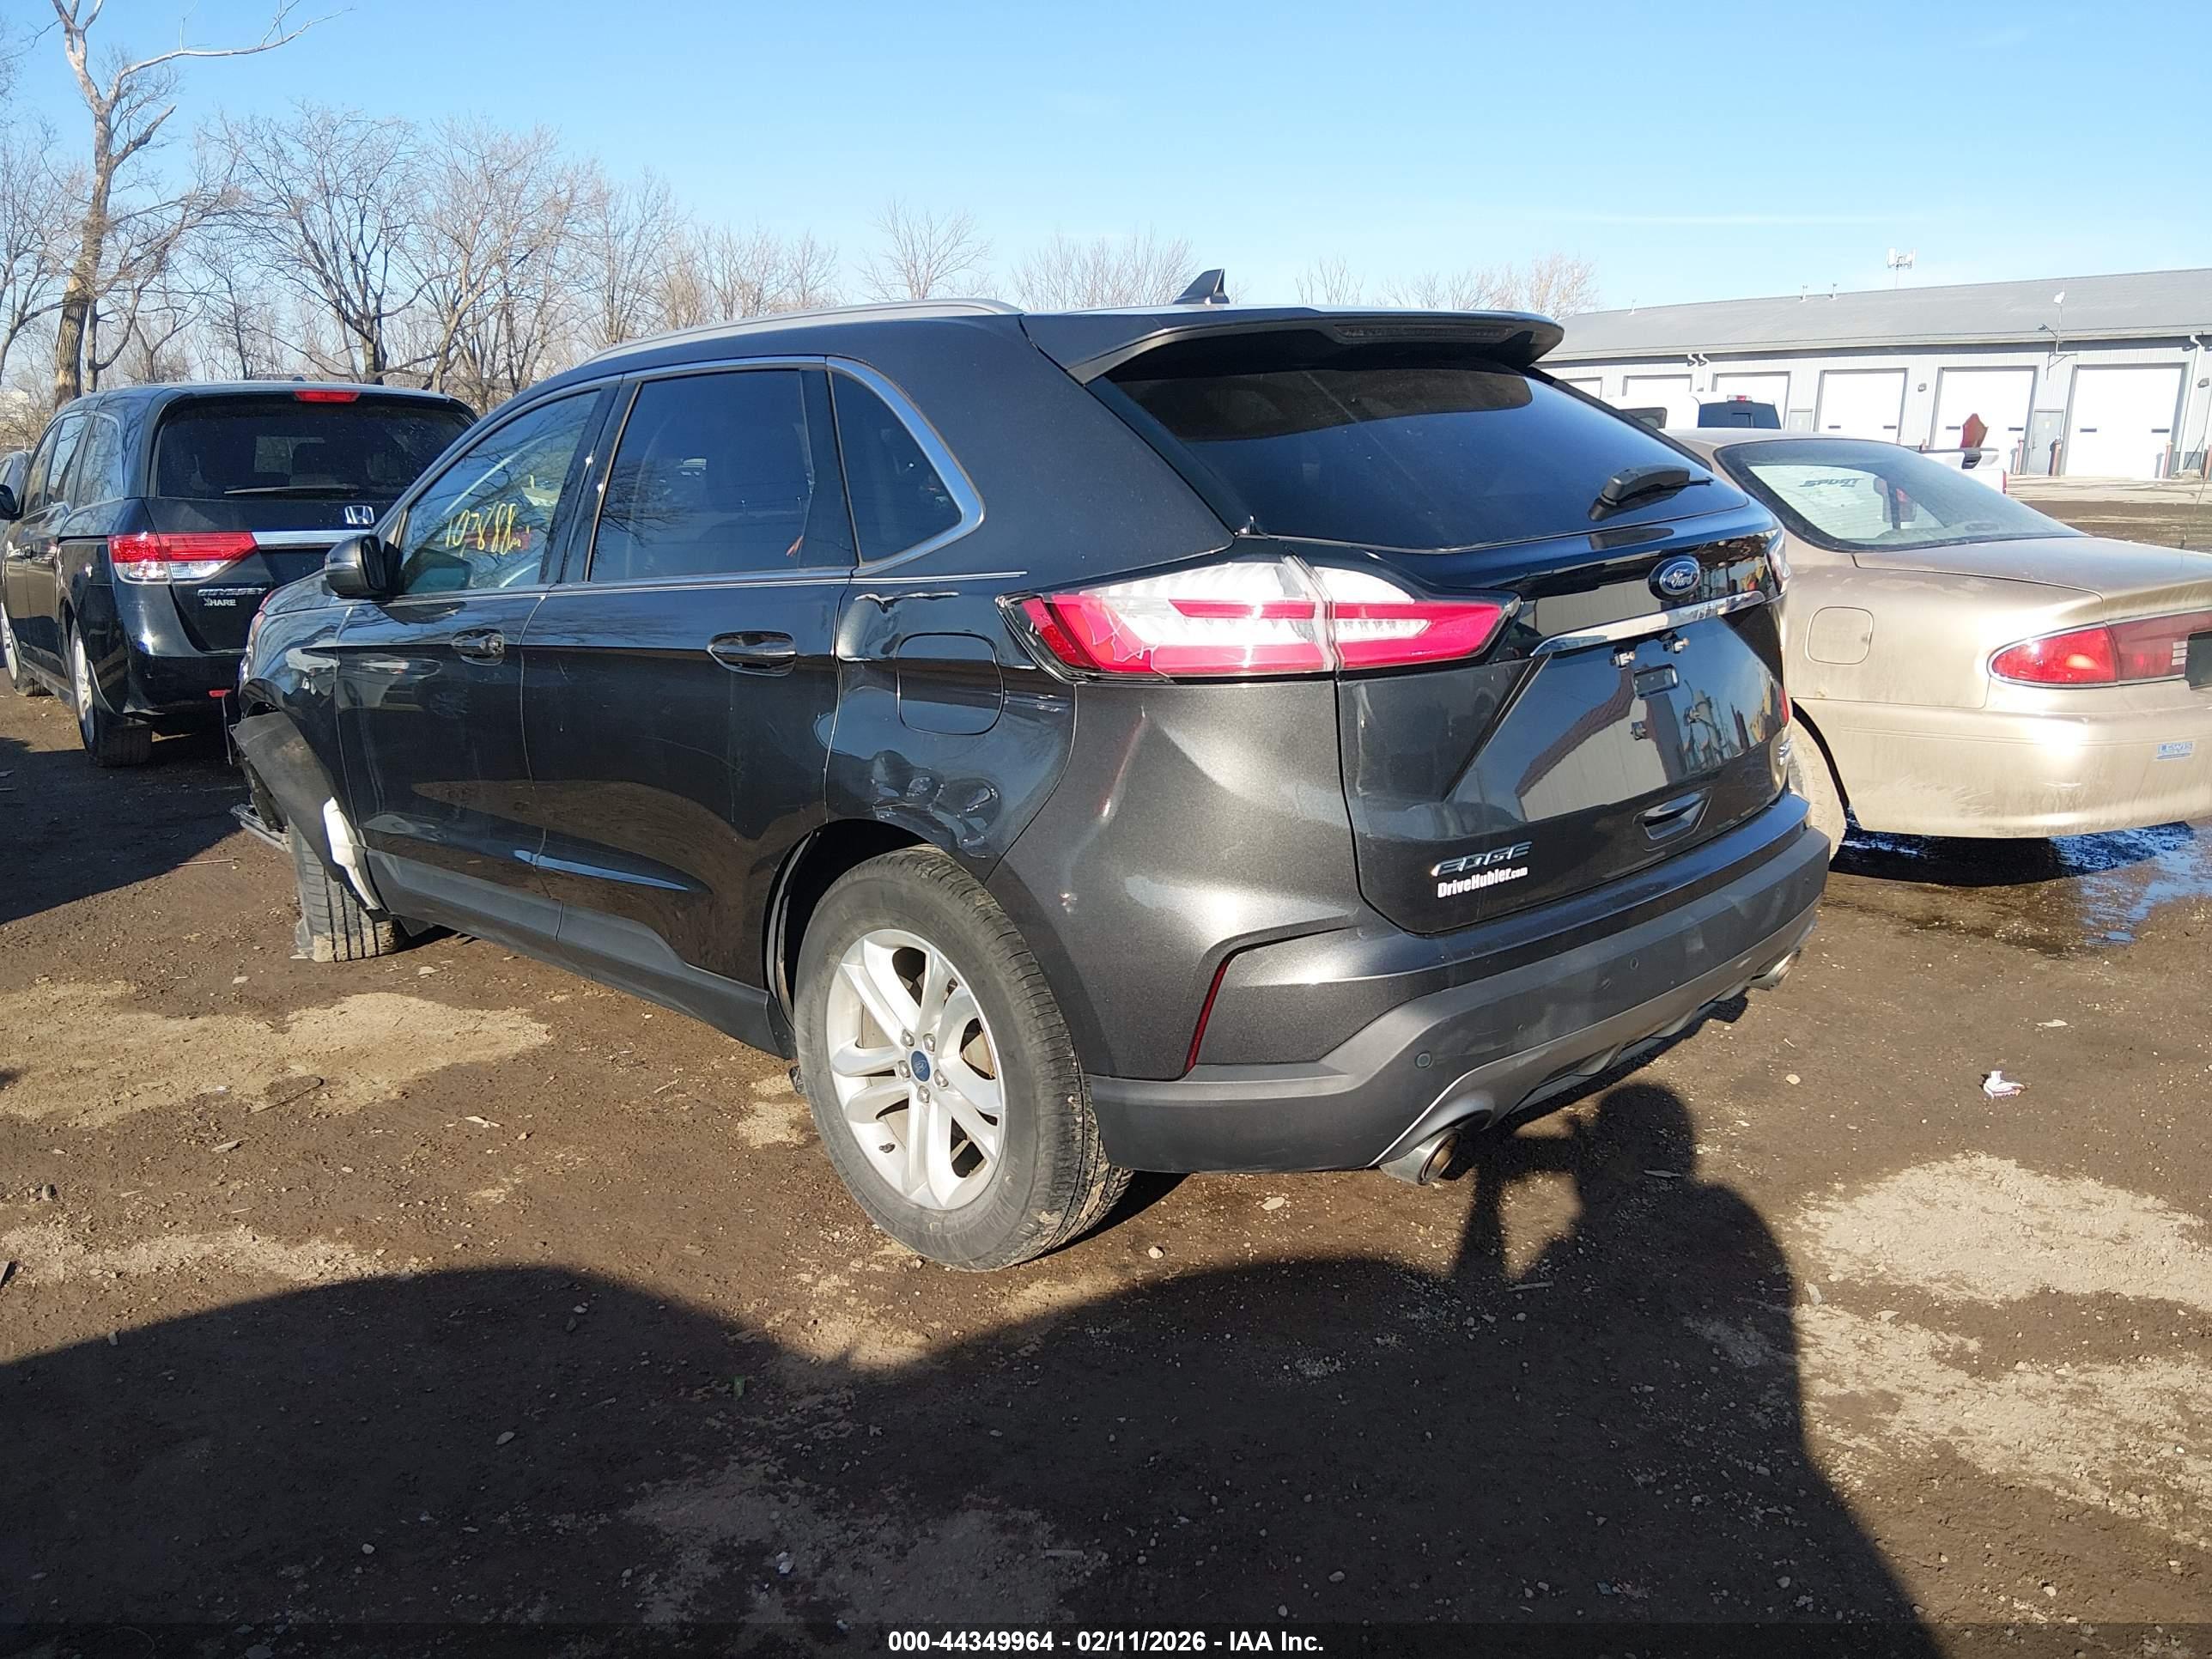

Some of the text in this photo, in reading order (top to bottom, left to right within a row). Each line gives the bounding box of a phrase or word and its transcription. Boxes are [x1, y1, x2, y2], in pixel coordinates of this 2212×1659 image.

[1798, 477, 1865, 488] SPORT
[198, 587, 267, 597] ODYSSEY
[1430, 841, 1533, 877] EDGE
[1437, 866, 1528, 898] DriveHubler.com
